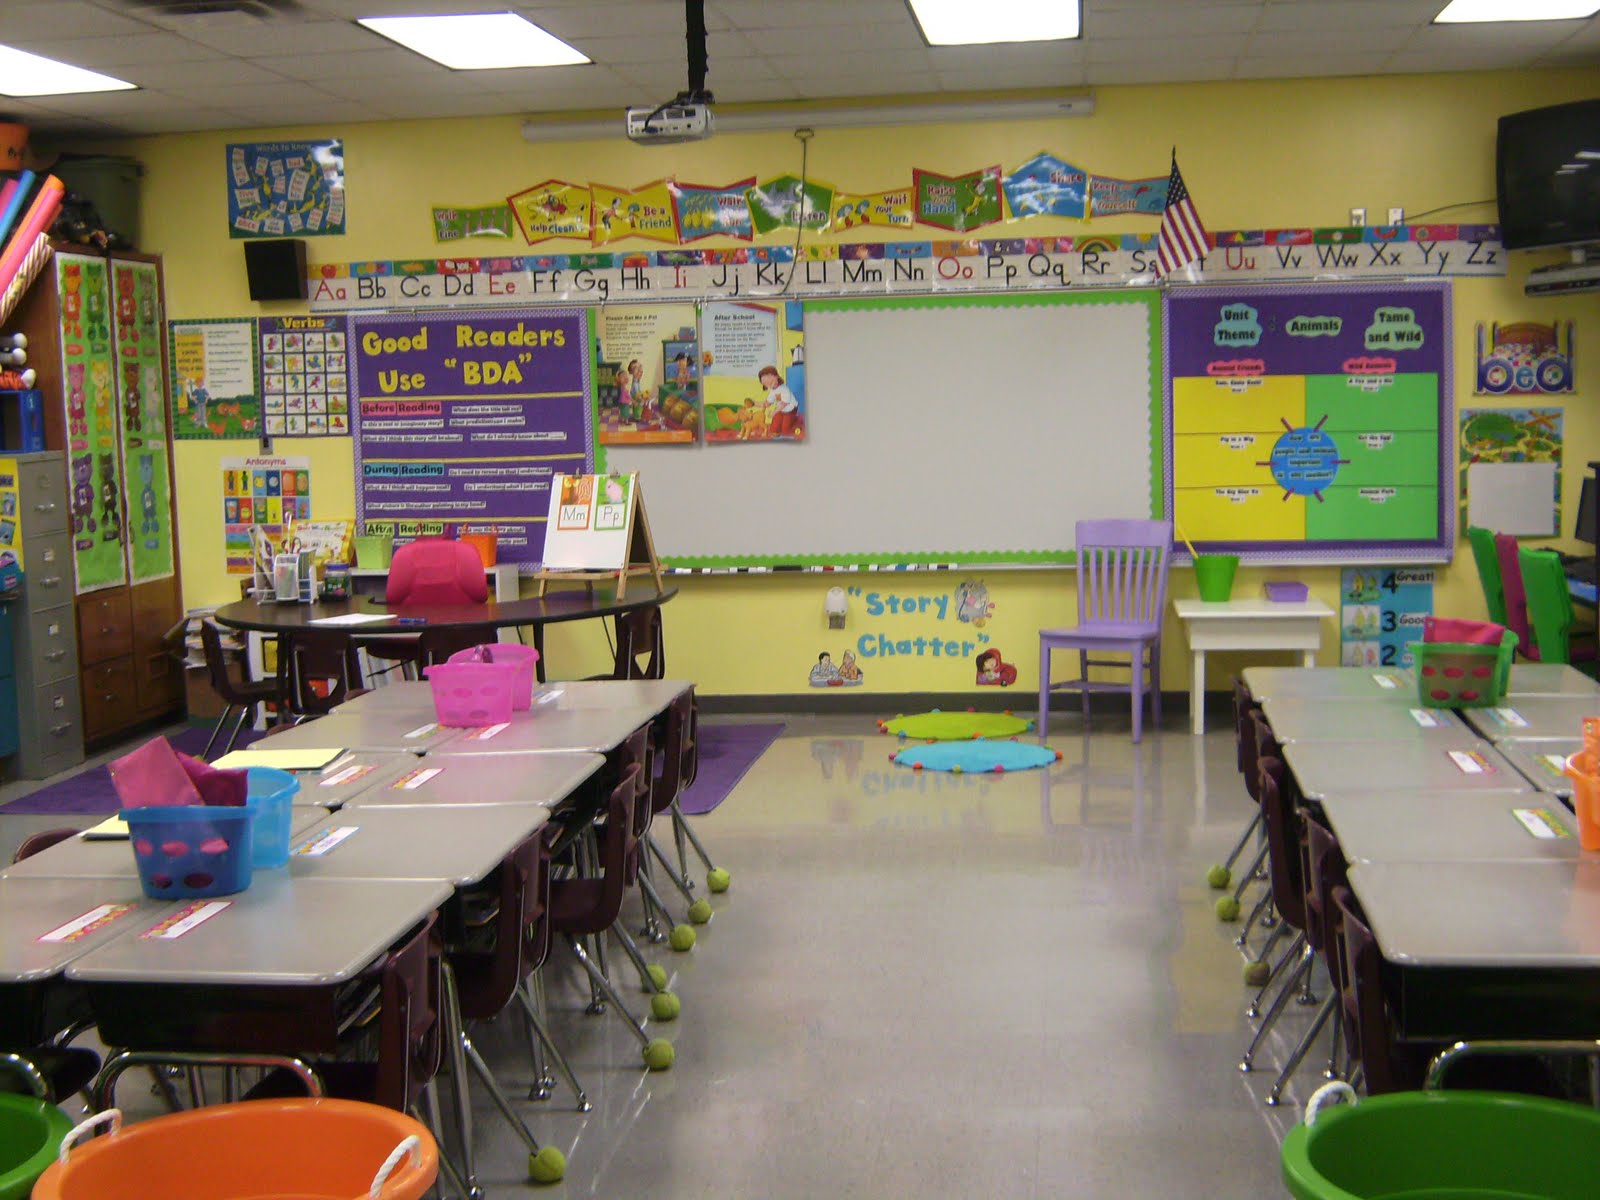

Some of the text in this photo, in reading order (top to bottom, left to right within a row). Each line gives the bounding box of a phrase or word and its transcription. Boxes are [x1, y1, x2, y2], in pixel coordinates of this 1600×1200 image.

[1050, 172, 1083, 184] Share
[927, 184, 956, 195] Raise
[884, 193, 908, 206] Wait
[1097, 198, 1137, 210] Yourself
[642, 205, 666, 216] Be a
[874, 204, 892, 214] Your
[923, 199, 957, 215] Hand
[639, 216, 672, 230] Friend
[888, 213, 910, 224] Turn
[530, 222, 576, 234] Help Clean
[314, 280, 346, 300] Aa
[358, 277, 386, 299] Bb
[400, 275, 430, 298] Cc
[444, 274, 474, 296] Dd
[489, 272, 516, 295] Ee
[532, 270, 561, 293] Ff
[574, 268, 609, 299] Gg
[622, 266, 650, 290] Hh
[674, 265, 687, 288] Ii
[712, 264, 739, 296] Jj
[757, 262, 784, 285] Kk
[806, 261, 826, 283] Ll
[843, 260, 882, 282] Mm
[894, 258, 924, 280] Nn
[938, 256, 973, 279] Oo
[987, 256, 1017, 285] Pp
[1028, 253, 1071, 286] Qq
[1082, 251, 1110, 275] Rr
[1226, 246, 1254, 270] Uu
[1276, 245, 1301, 268] Vv
[1316, 244, 1358, 268] Ww
[1370, 242, 1401, 266] Xx
[1418, 242, 1449, 274] Yy
[1467, 241, 1496, 264] Zz
[1224, 309, 1250, 321] Unit
[1380, 312, 1410, 322] Tame
[282, 317, 325, 330] Verbs
[1291, 319, 1340, 332] Animals
[362, 322, 566, 356] Good Readers
[1218, 329, 1256, 340] Theme
[1368, 330, 1422, 342] and Wild
[378, 370, 426, 393] Use
[362, 402, 440, 414] Before Reading
[246, 458, 287, 468] Antonyms
[364, 465, 444, 476] During Reading
[563, 506, 620, 527] Mm Pp
[1382, 570, 1434, 594] 4 Great!
[1382, 610, 1396, 632] 3
[1382, 644, 1397, 666] 2
